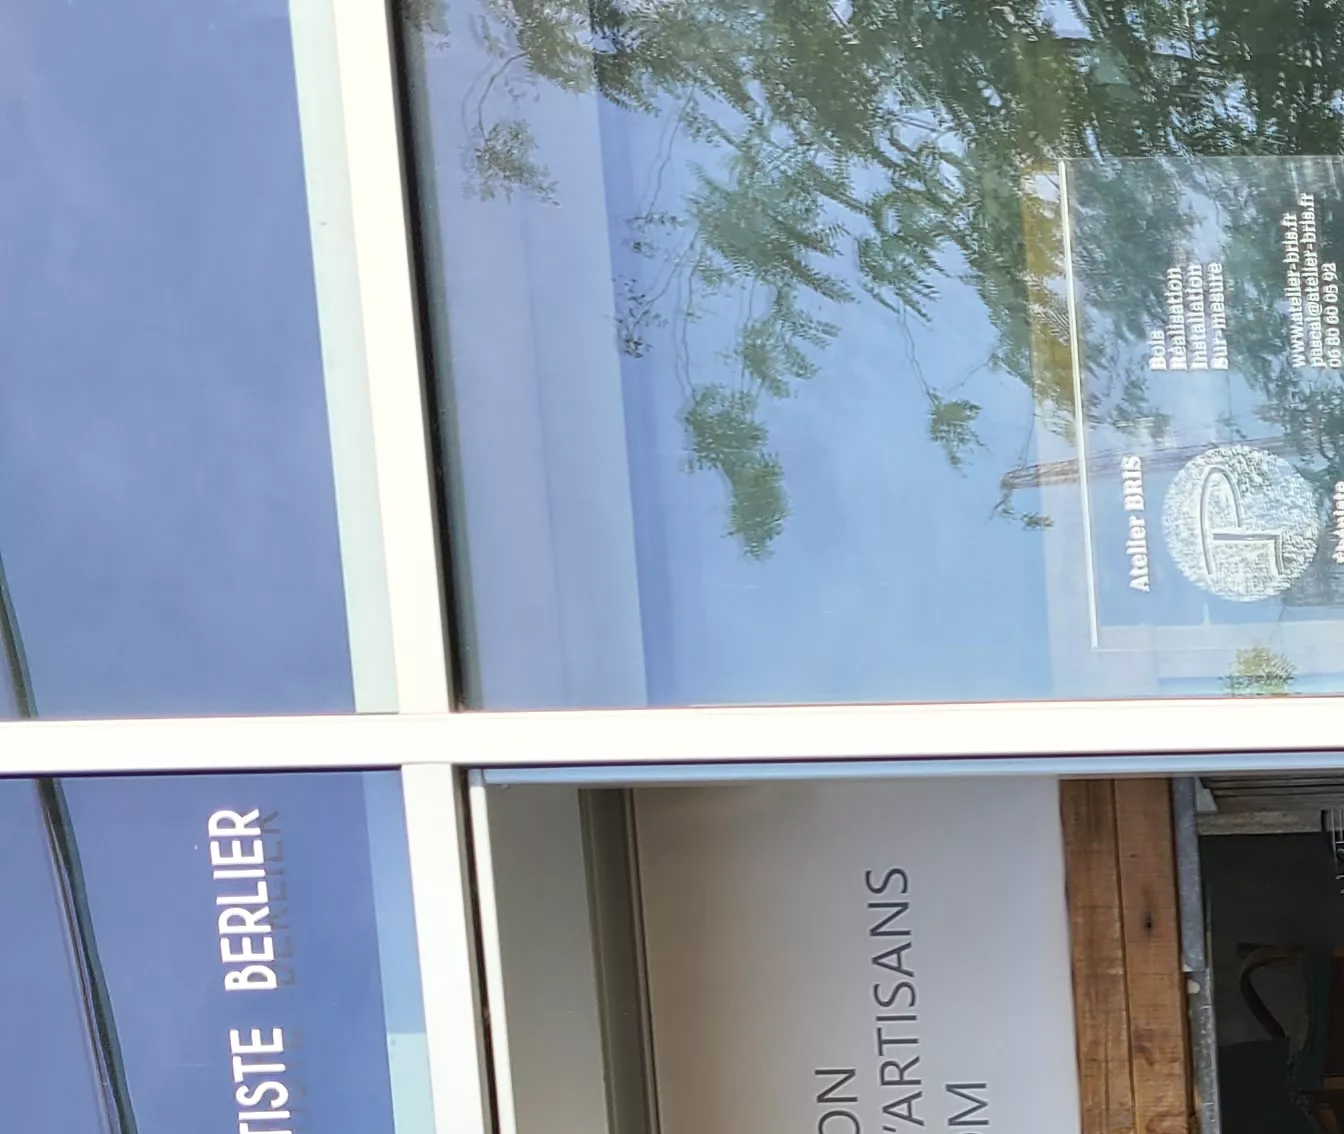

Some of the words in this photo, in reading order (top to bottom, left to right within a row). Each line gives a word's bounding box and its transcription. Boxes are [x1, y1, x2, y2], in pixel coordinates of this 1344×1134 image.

[1164, 267, 1187, 370] Réalisation
[1184, 264, 1208, 370] Installation
[1206, 262, 1229, 370] Sur-mesure
[1280, 212, 1305, 368] www.atelier-bris.fr
[1299, 191, 1327, 367] pascal@atelier-bris.fr
[1146, 330, 1167, 370] Bois
[1327, 348, 1342, 368] 06
[1120, 455, 1145, 511] BRIS
[1125, 516, 1150, 592] Atelier
[208, 808, 278, 991] BERLIER
